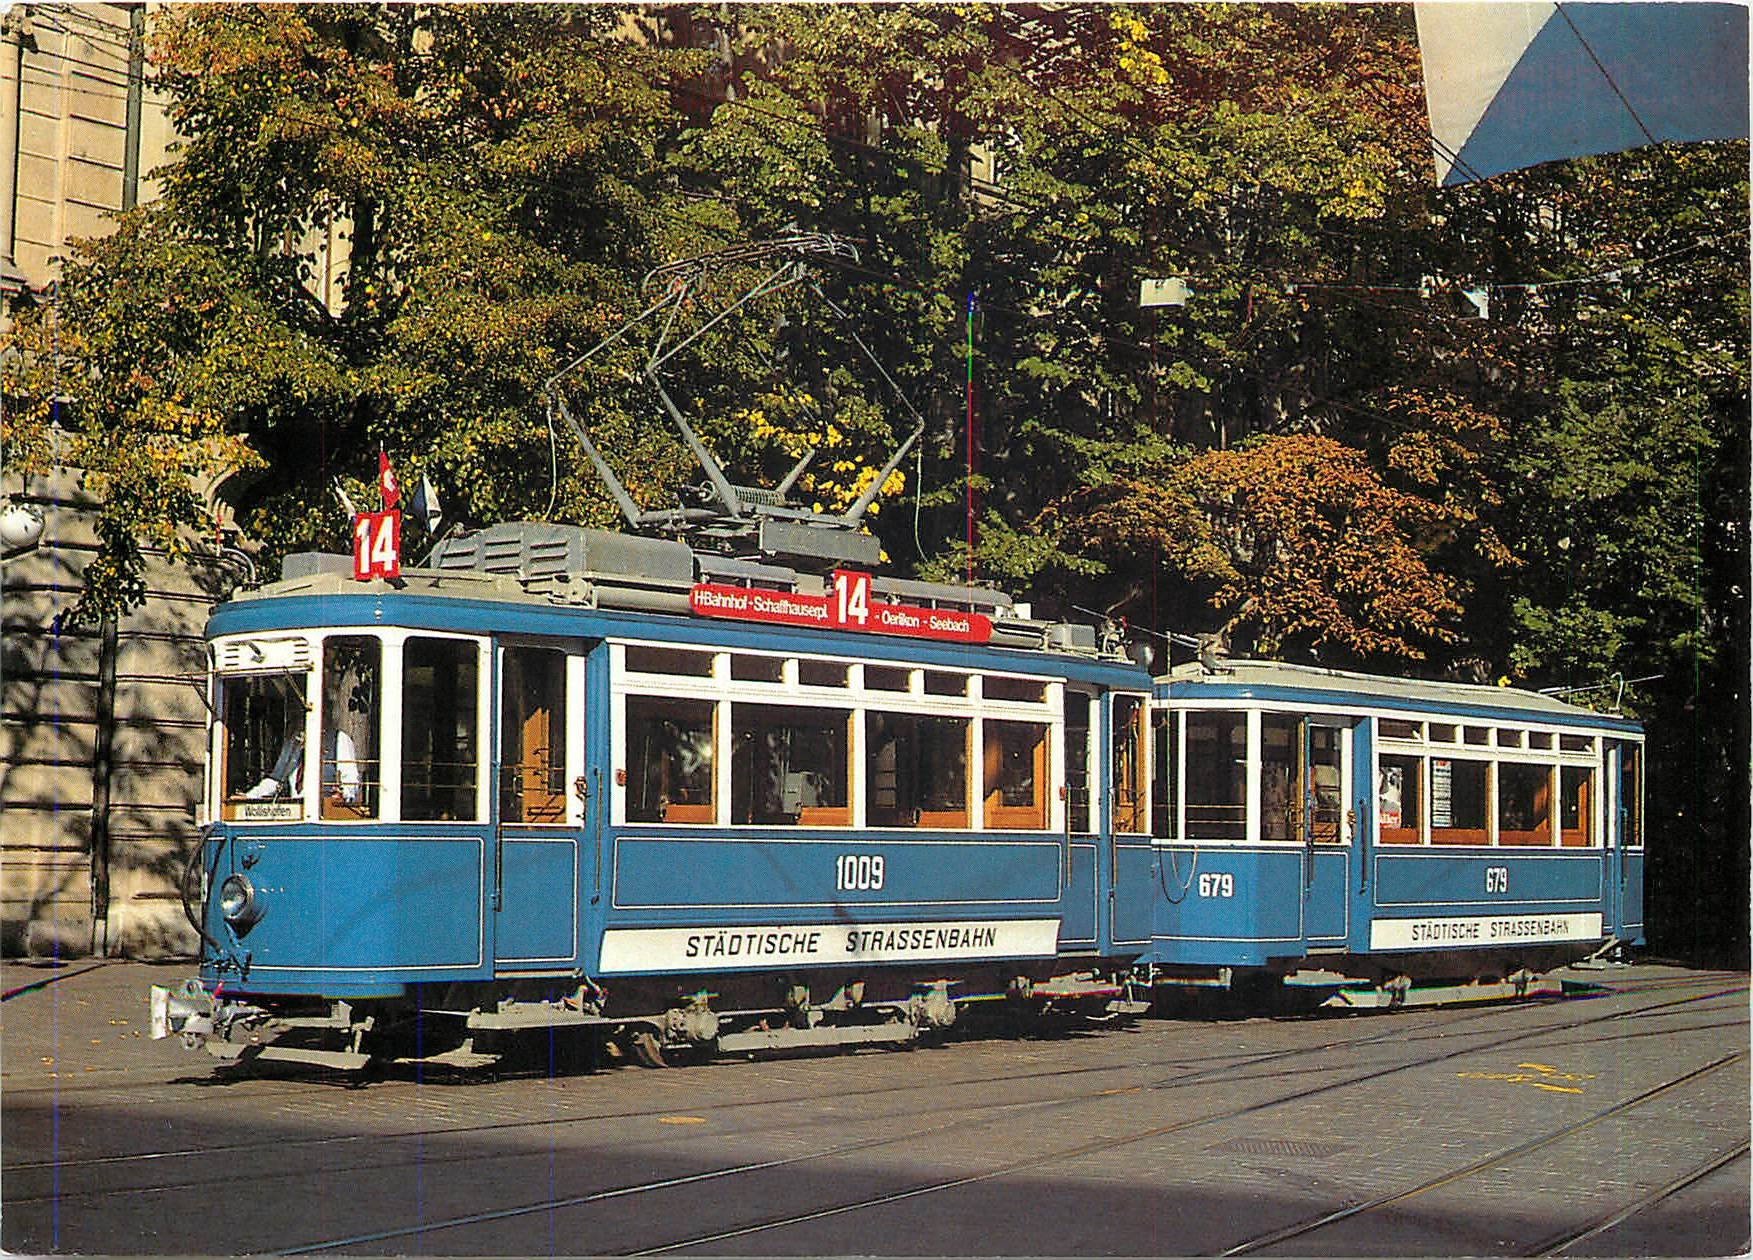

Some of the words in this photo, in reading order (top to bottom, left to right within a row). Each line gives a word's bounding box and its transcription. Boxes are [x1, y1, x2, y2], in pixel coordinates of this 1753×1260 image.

[356, 515, 397, 574] 14
[835, 575, 869, 625] 14
[882, 610, 920, 628] Oerlikon
[929, 615, 970, 633] Seebach
[837, 855, 884, 890] 1009
[1199, 873, 1234, 897] 679
[1485, 867, 1508, 893] 679
[686, 930, 822, 957] STÄDTISCHE
[846, 927, 998, 952] STRASSENBAHN
[1412, 919, 1481, 942] STÄDTISCHE
[1490, 916, 1570, 938] STRASSENBAHN
